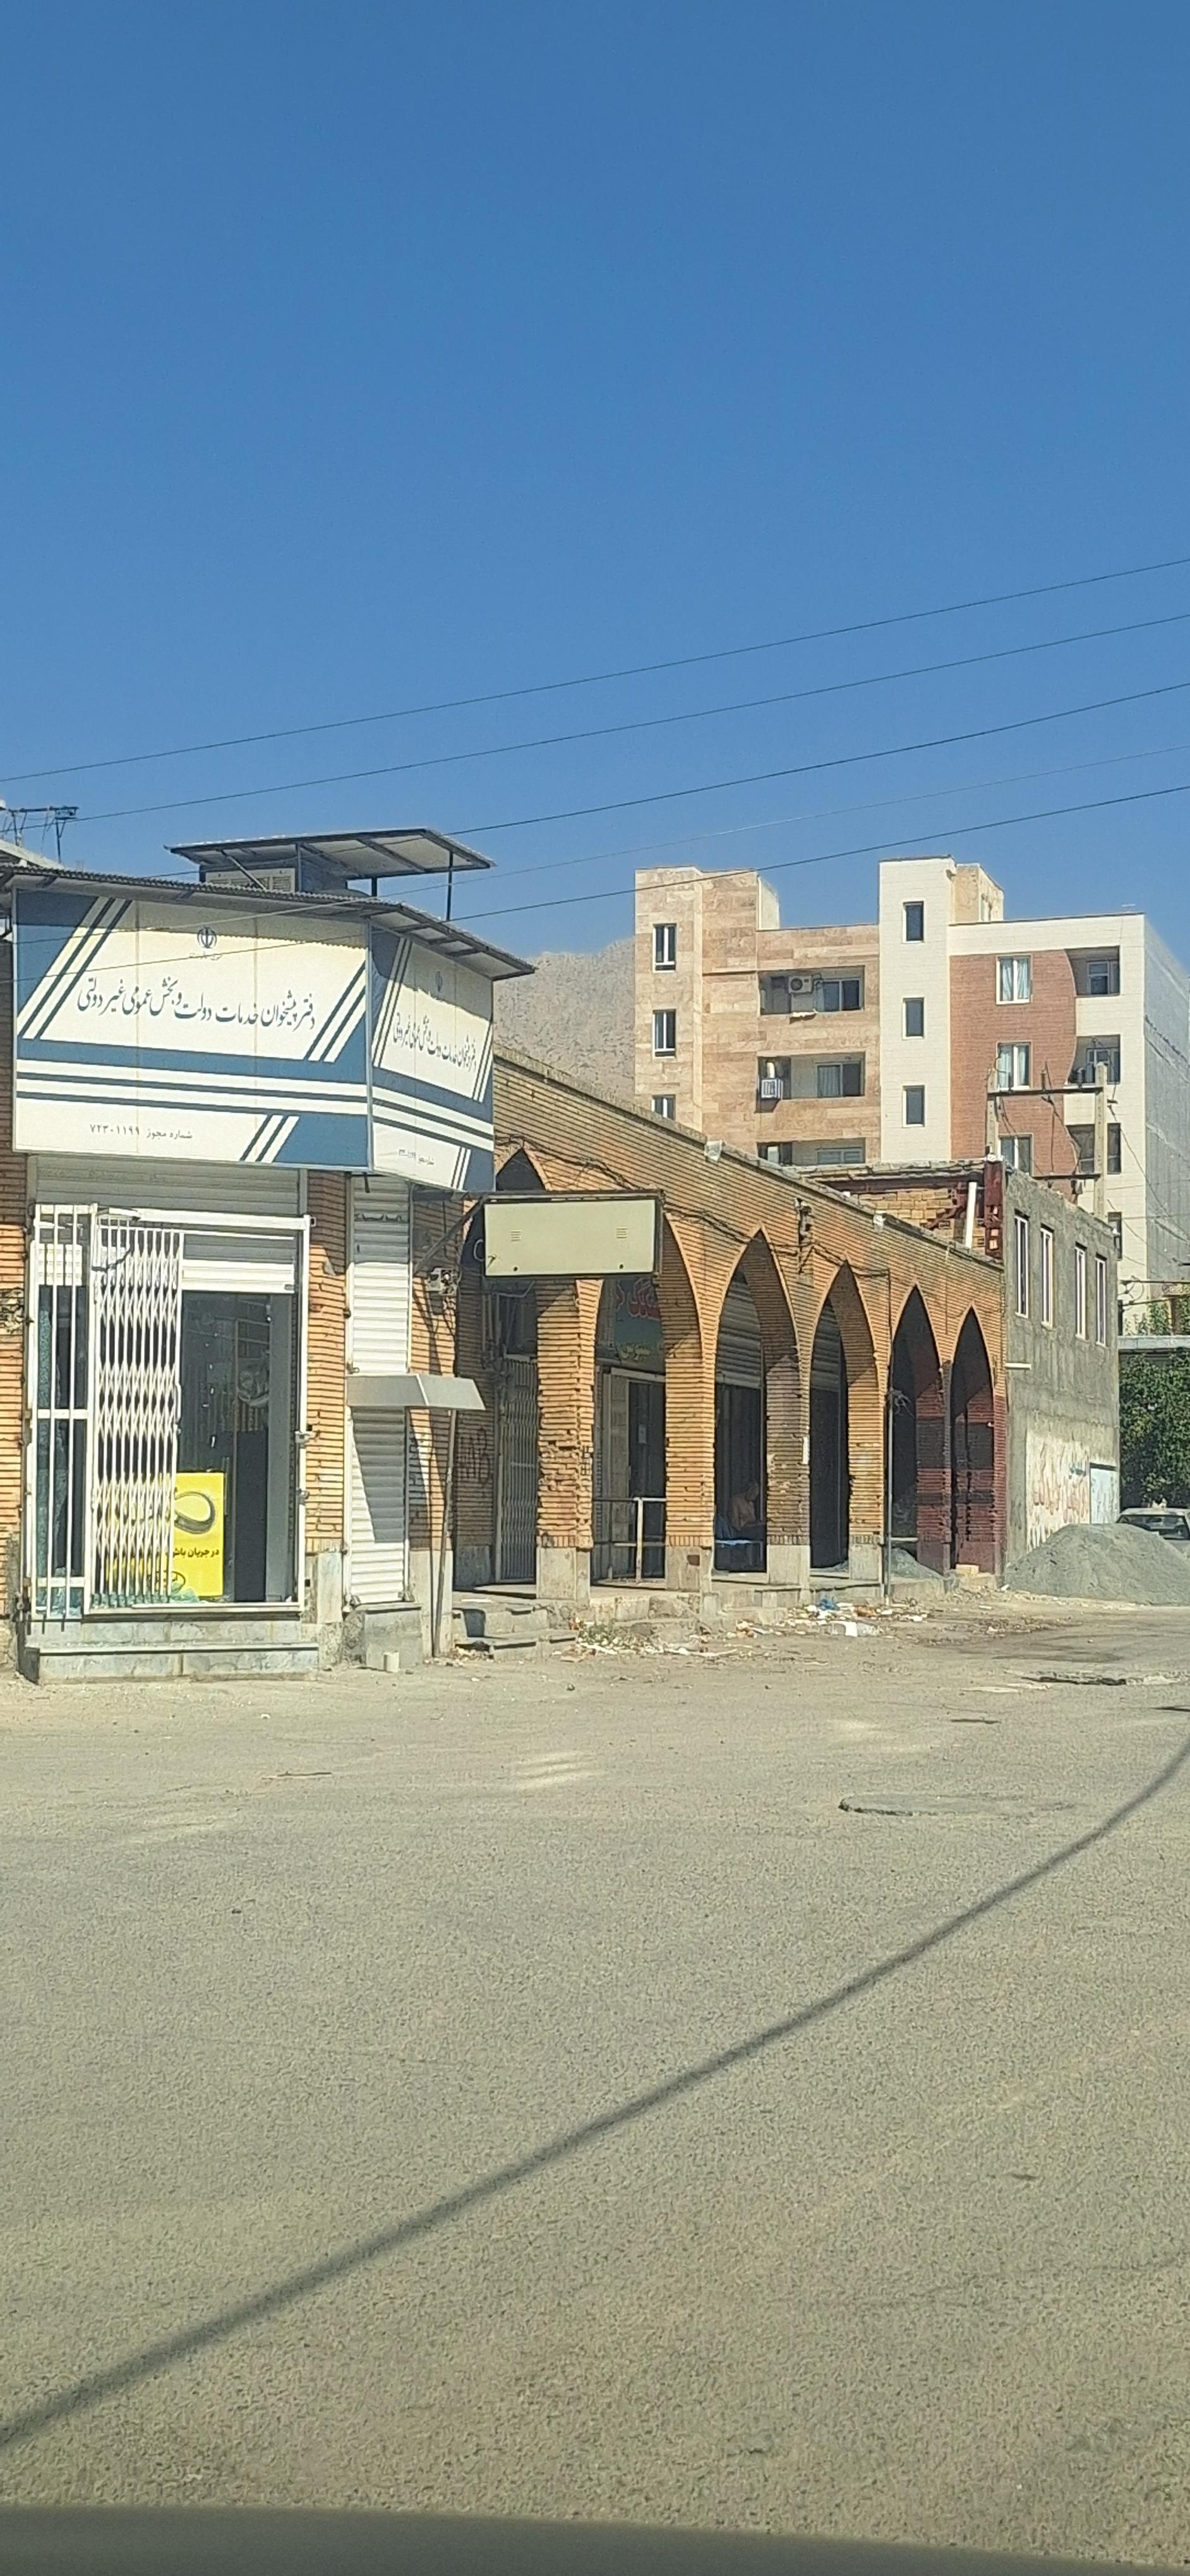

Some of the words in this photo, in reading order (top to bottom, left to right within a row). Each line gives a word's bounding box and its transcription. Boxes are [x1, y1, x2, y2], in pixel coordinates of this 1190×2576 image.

[77, 977, 103, 1011] دولتی
[98, 979, 126, 1015] غیر
[122, 986, 152, 1015] عمومی
[149, 976, 178, 1016] بخش
[174, 992, 212, 1021] دولت
[261, 989, 298, 1027] پیشخوان
[215, 1001, 258, 1025] خدمات
[292, 993, 315, 1032] دفتر
[90, 1124, 140, 1135] ۷۲۳۰۱۱۹۹
[146, 1128, 167, 1140] مجوز
[169, 1130, 193, 1140] شماره
[188, 1547, 210, 1558] جریان
